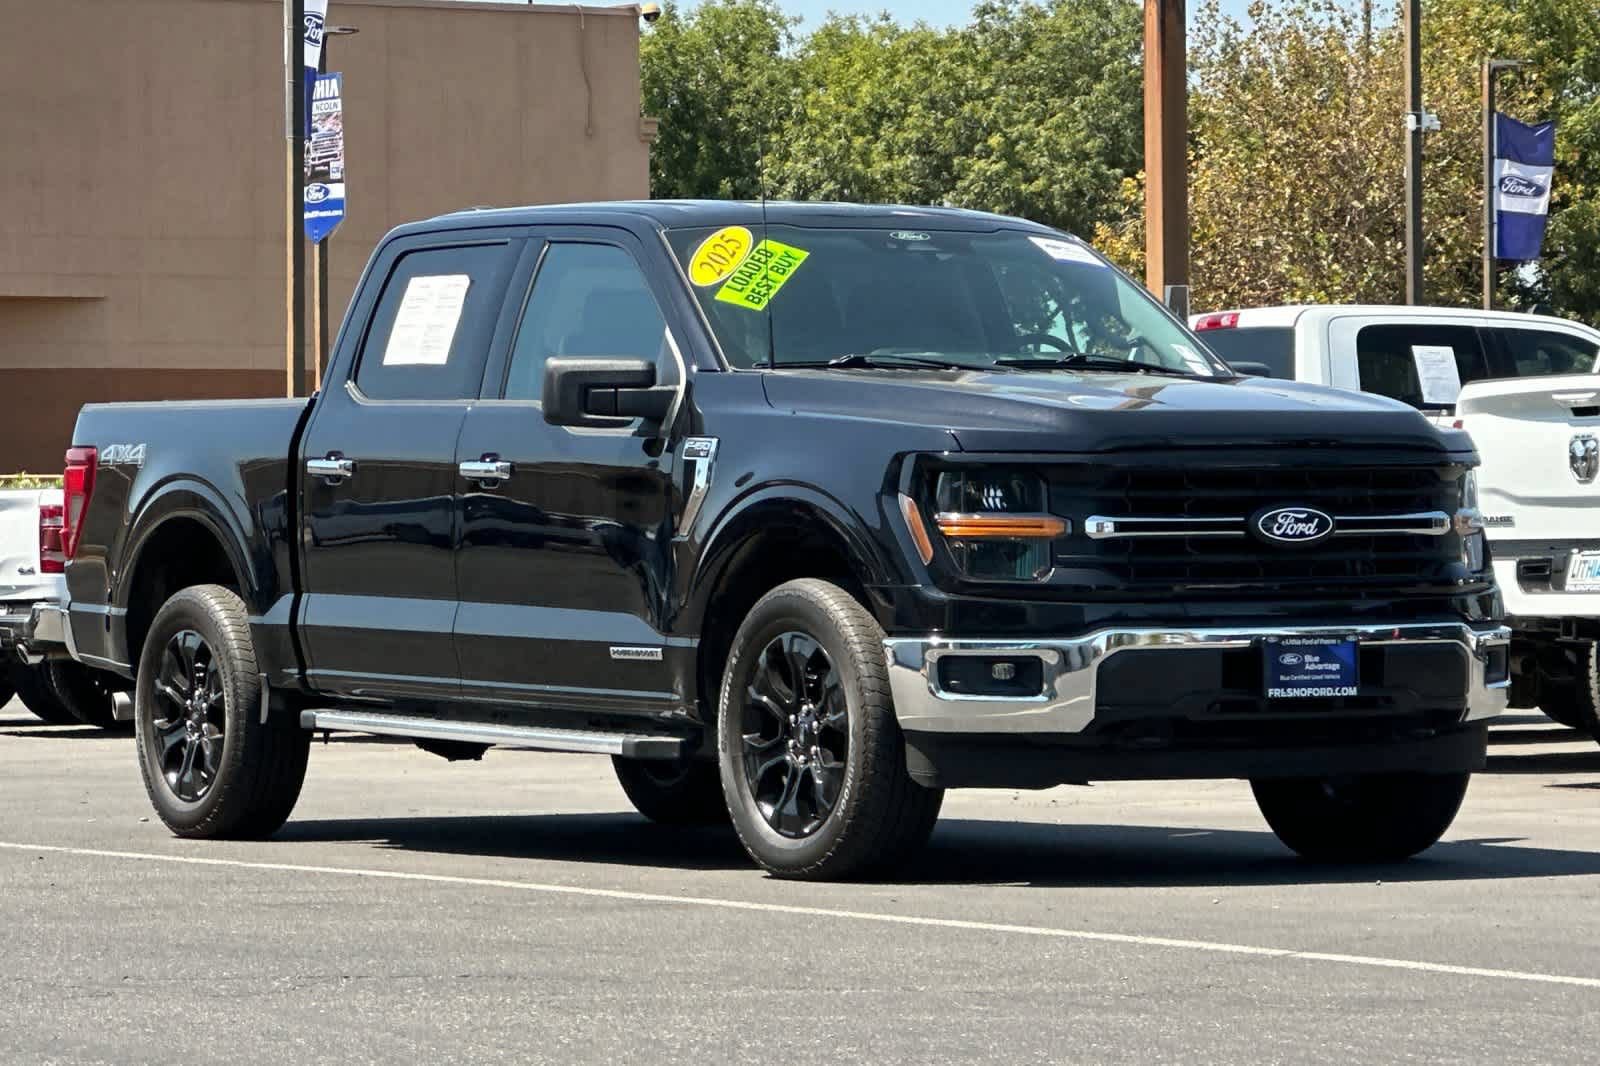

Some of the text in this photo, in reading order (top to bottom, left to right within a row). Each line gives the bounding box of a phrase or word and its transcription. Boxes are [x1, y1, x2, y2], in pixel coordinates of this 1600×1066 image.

[304, 15, 323, 40] For
[1501, 176, 1537, 195] Ford
[700, 233, 742, 277] 2025
[726, 248, 775, 293] LOADED
[744, 250, 799, 305] BEST BUY
[1273, 512, 1319, 535] Ford
[1304, 654, 1320, 663] Blue
[1304, 663, 1340, 671] Advantage
